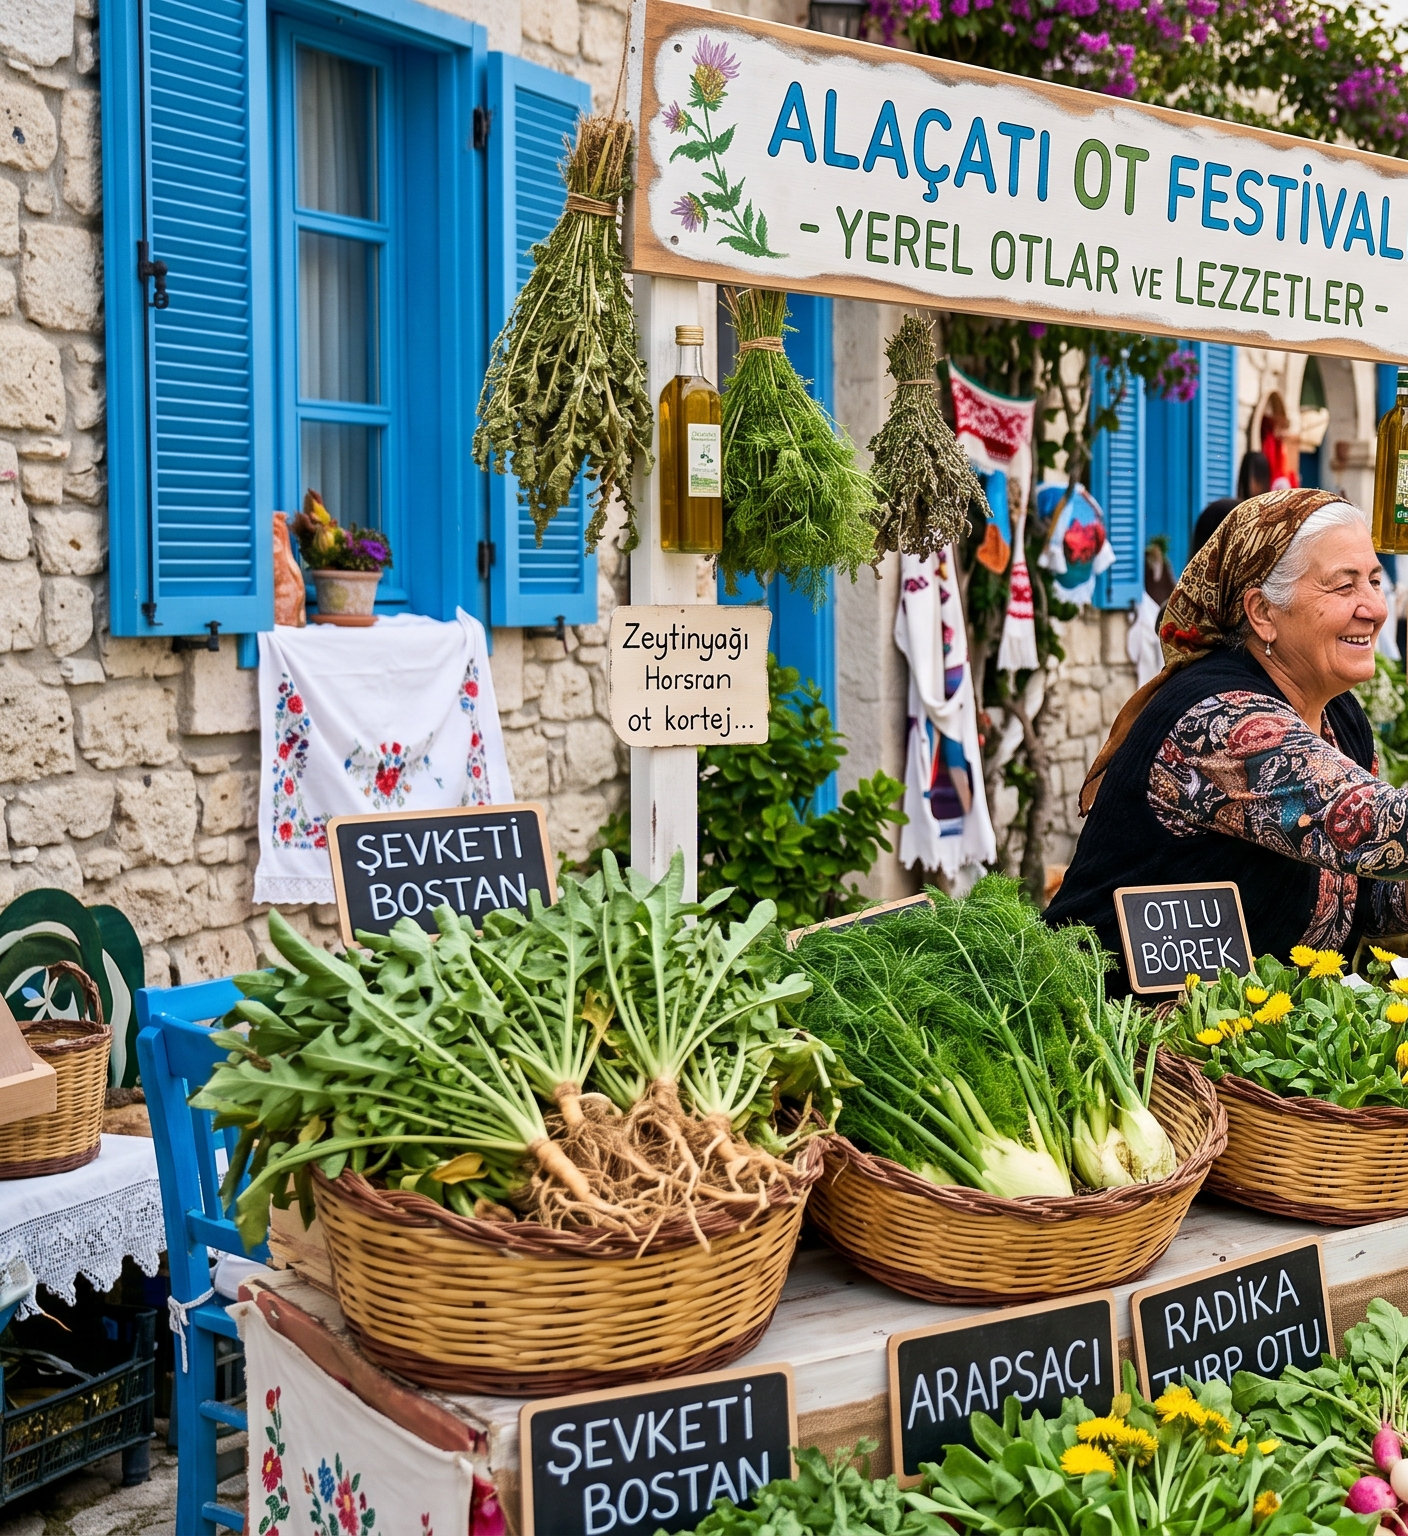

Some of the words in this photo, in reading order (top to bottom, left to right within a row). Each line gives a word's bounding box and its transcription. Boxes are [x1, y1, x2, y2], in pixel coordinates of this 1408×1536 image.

[767, 81, 1051, 203] ALAÇATI
[1074, 138, 1150, 216] OT
[836, 205, 974, 276] YEREL
[991, 230, 1119, 294] OTLAR
[1132, 265, 1163, 300] VE
[1175, 256, 1365, 328] LEZZETLER
[622, 622, 749, 662] Zeytinyağı
[645, 664, 732, 690] Horsran
[628, 706, 652, 732] ot
[665, 704, 754, 738] kortej...
[356, 817, 523, 877] ŞEVKETİ
[368, 872, 528, 921] BOSTAN
[1143, 898, 1221, 931] OTLU
[1141, 934, 1241, 975] BÖREK
[1164, 1268, 1301, 1350] RADİKA
[1256, 1318, 1321, 1373] OTU
[907, 1337, 1101, 1430] ARAPSAÇI
[547, 1383, 753, 1486] ŞEVKETİ
[583, 1450, 769, 1536] BOSTAN
